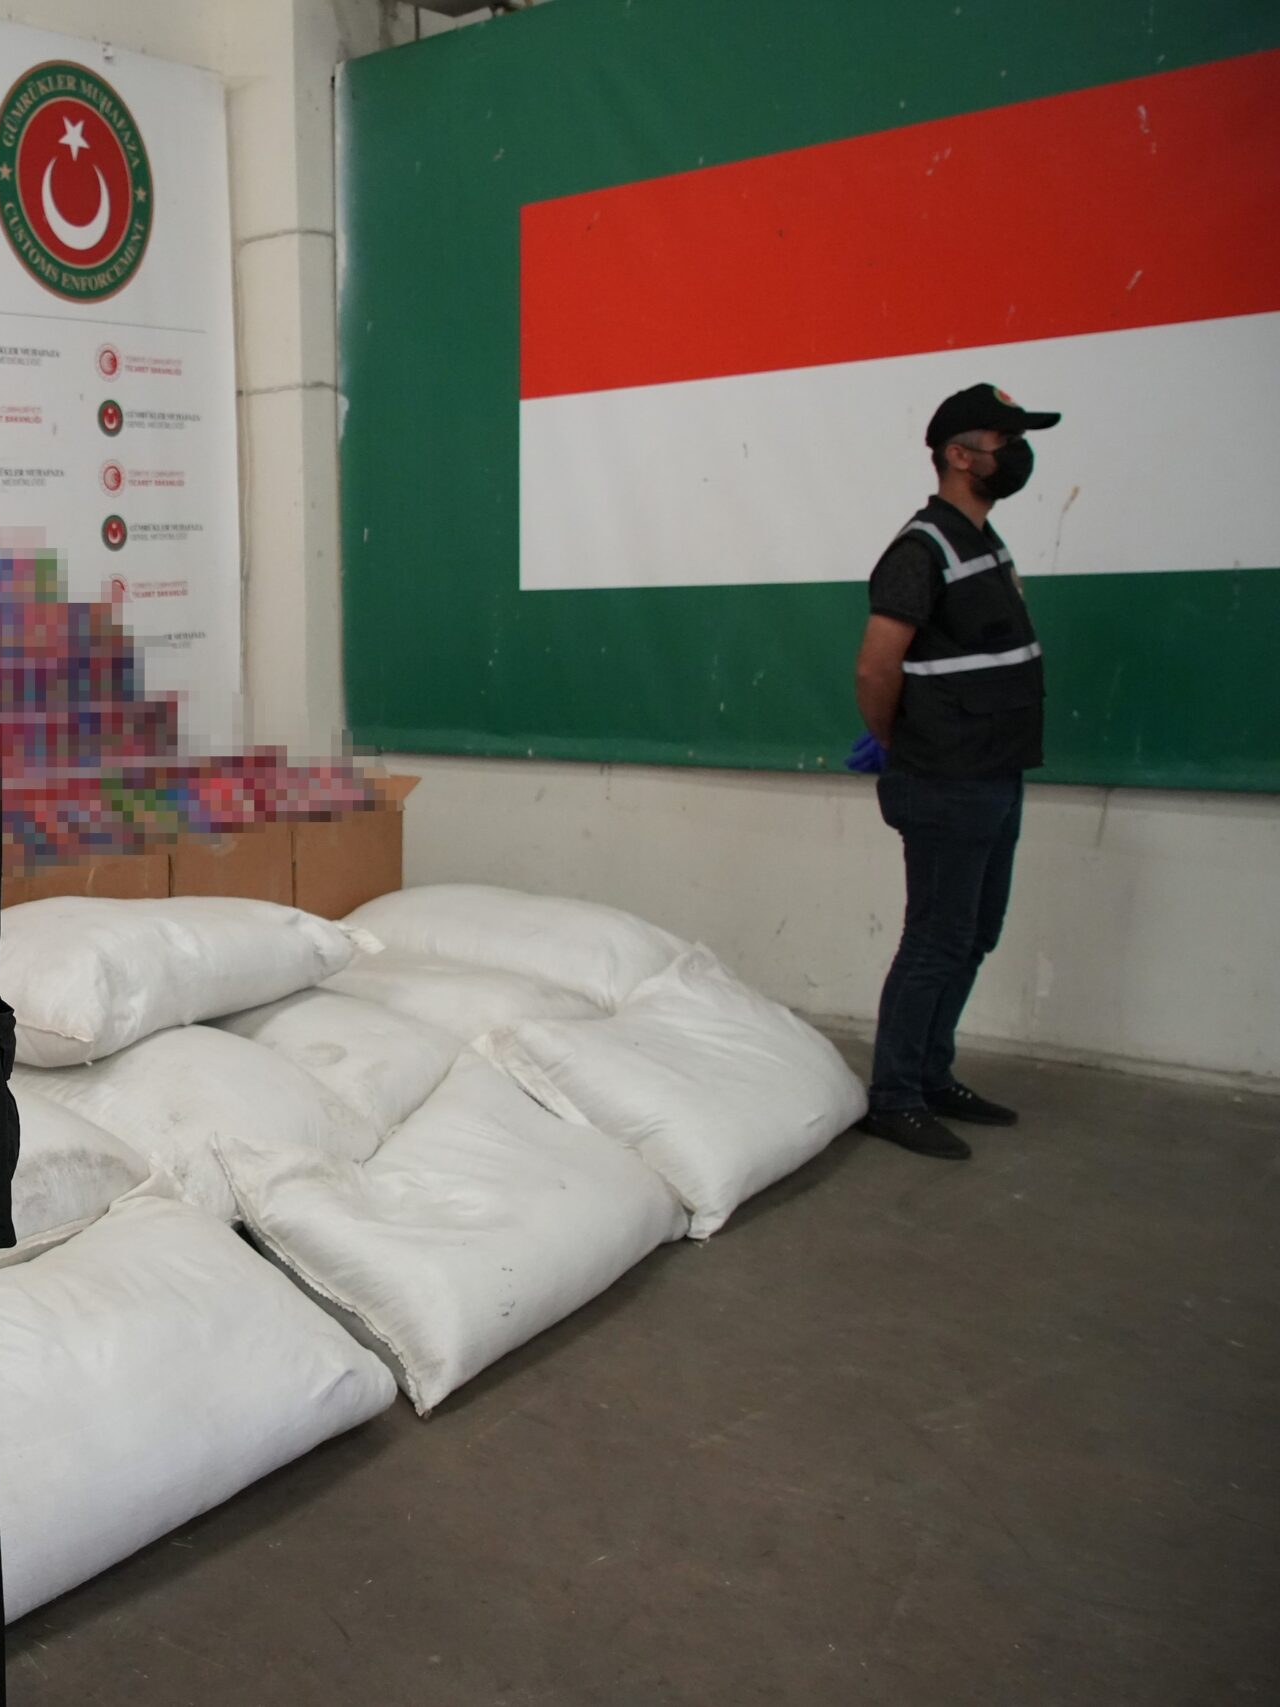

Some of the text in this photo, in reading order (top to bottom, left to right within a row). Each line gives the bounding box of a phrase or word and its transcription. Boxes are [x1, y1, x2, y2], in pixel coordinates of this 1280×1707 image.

[1, 74, 141, 169] GÜMRÜKLER MUHAFAZA
[3, 201, 145, 293] CUSTOMS ENFORCEMENT
